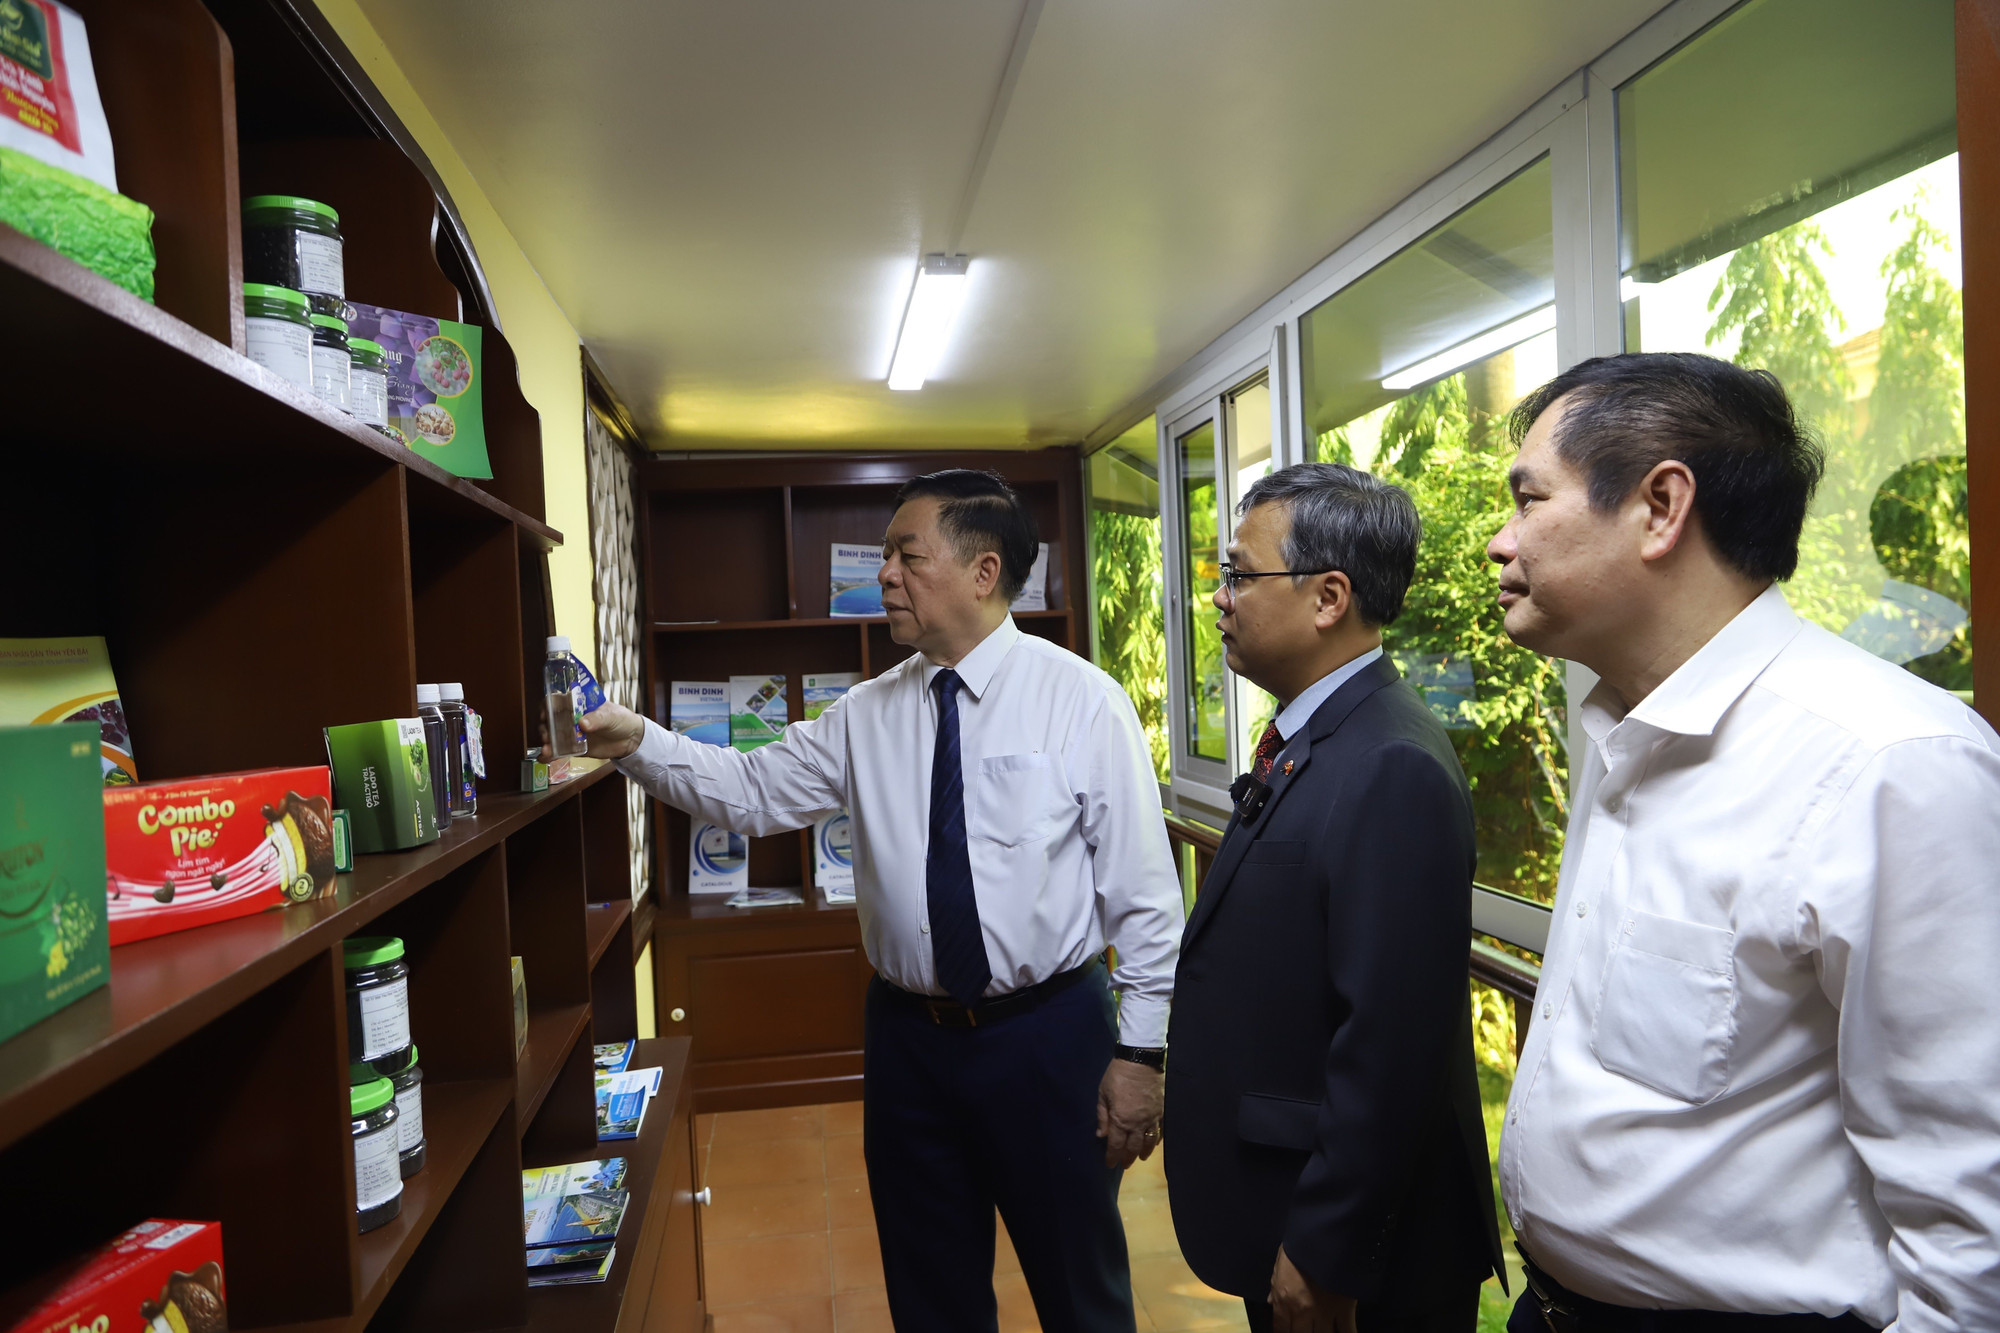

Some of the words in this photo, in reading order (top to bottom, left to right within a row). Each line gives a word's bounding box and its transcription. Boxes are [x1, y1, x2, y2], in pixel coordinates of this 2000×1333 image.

[838, 549, 859, 558] BINH
[860, 550, 882, 559] DINH
[368, 767, 377, 788] LADO
[138, 797, 235, 834] Combo
[170, 826, 215, 857] Pie
